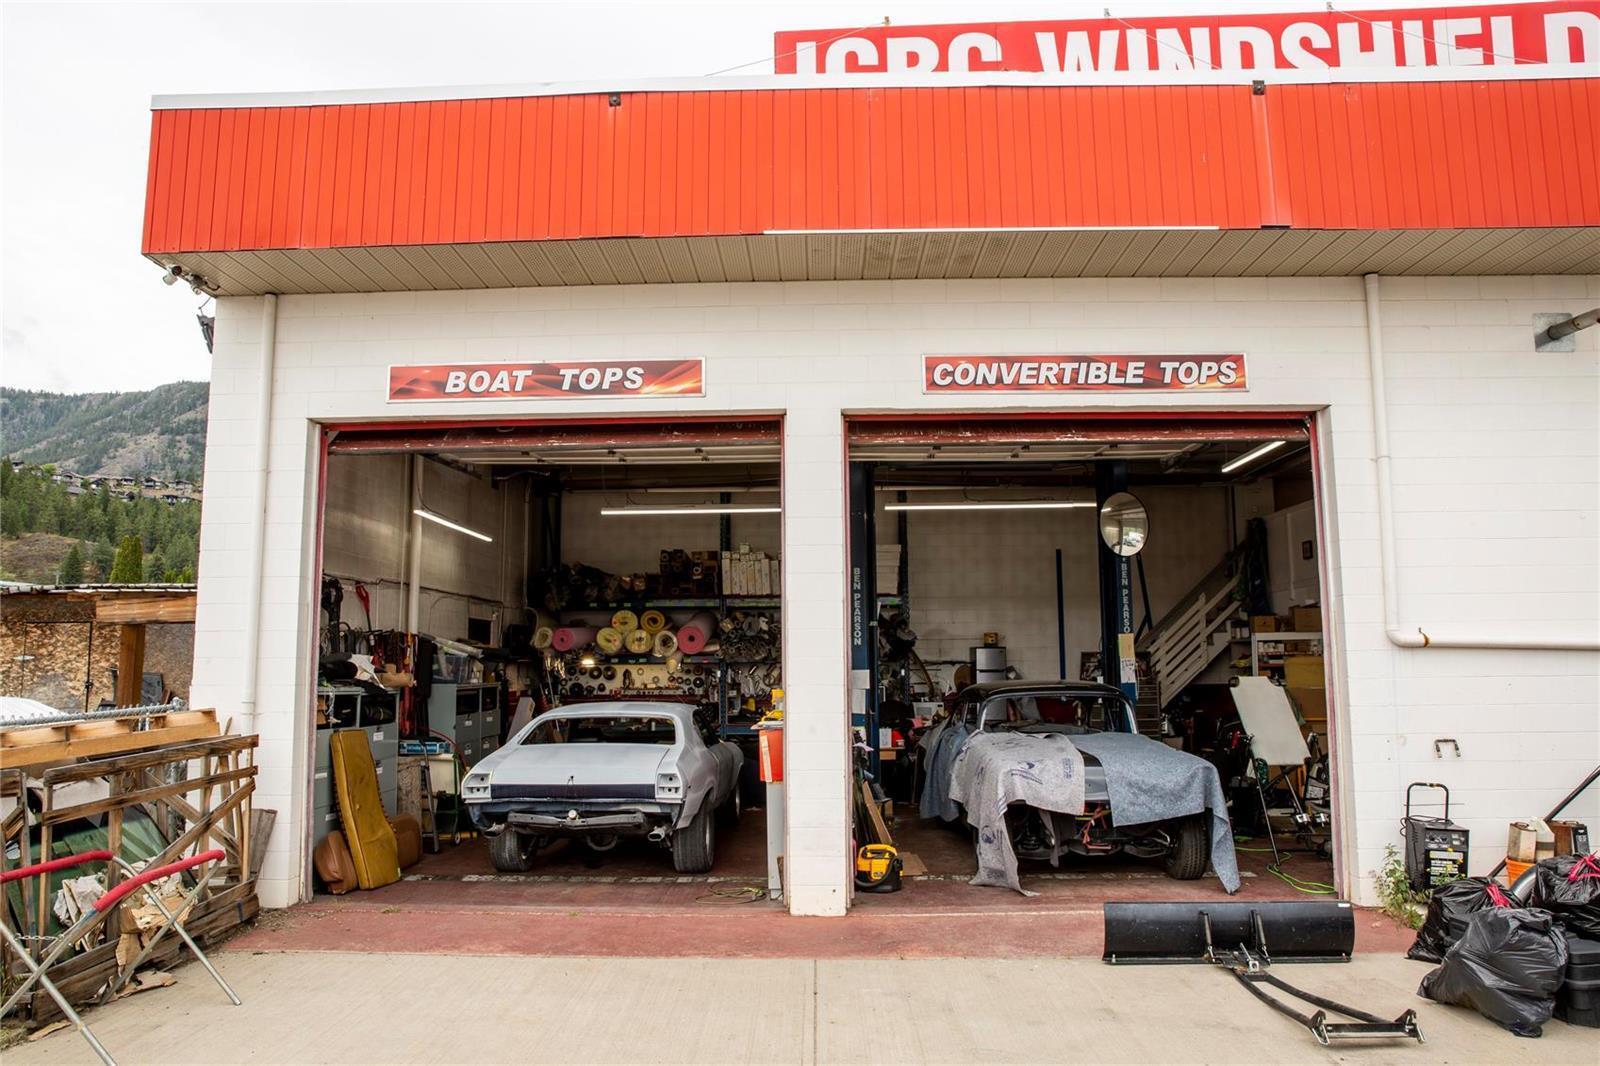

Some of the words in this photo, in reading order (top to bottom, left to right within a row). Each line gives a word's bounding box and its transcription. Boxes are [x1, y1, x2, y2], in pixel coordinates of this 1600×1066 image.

[445, 369, 533, 393] BOAT
[559, 367, 644, 391] TOPS
[932, 361, 1145, 386] CONVERTIBLE
[1160, 361, 1237, 384] TOPS
[1121, 563, 1129, 586] BEN
[853, 593, 862, 646] PEARSON
[1122, 588, 1131, 634] PEARSO
